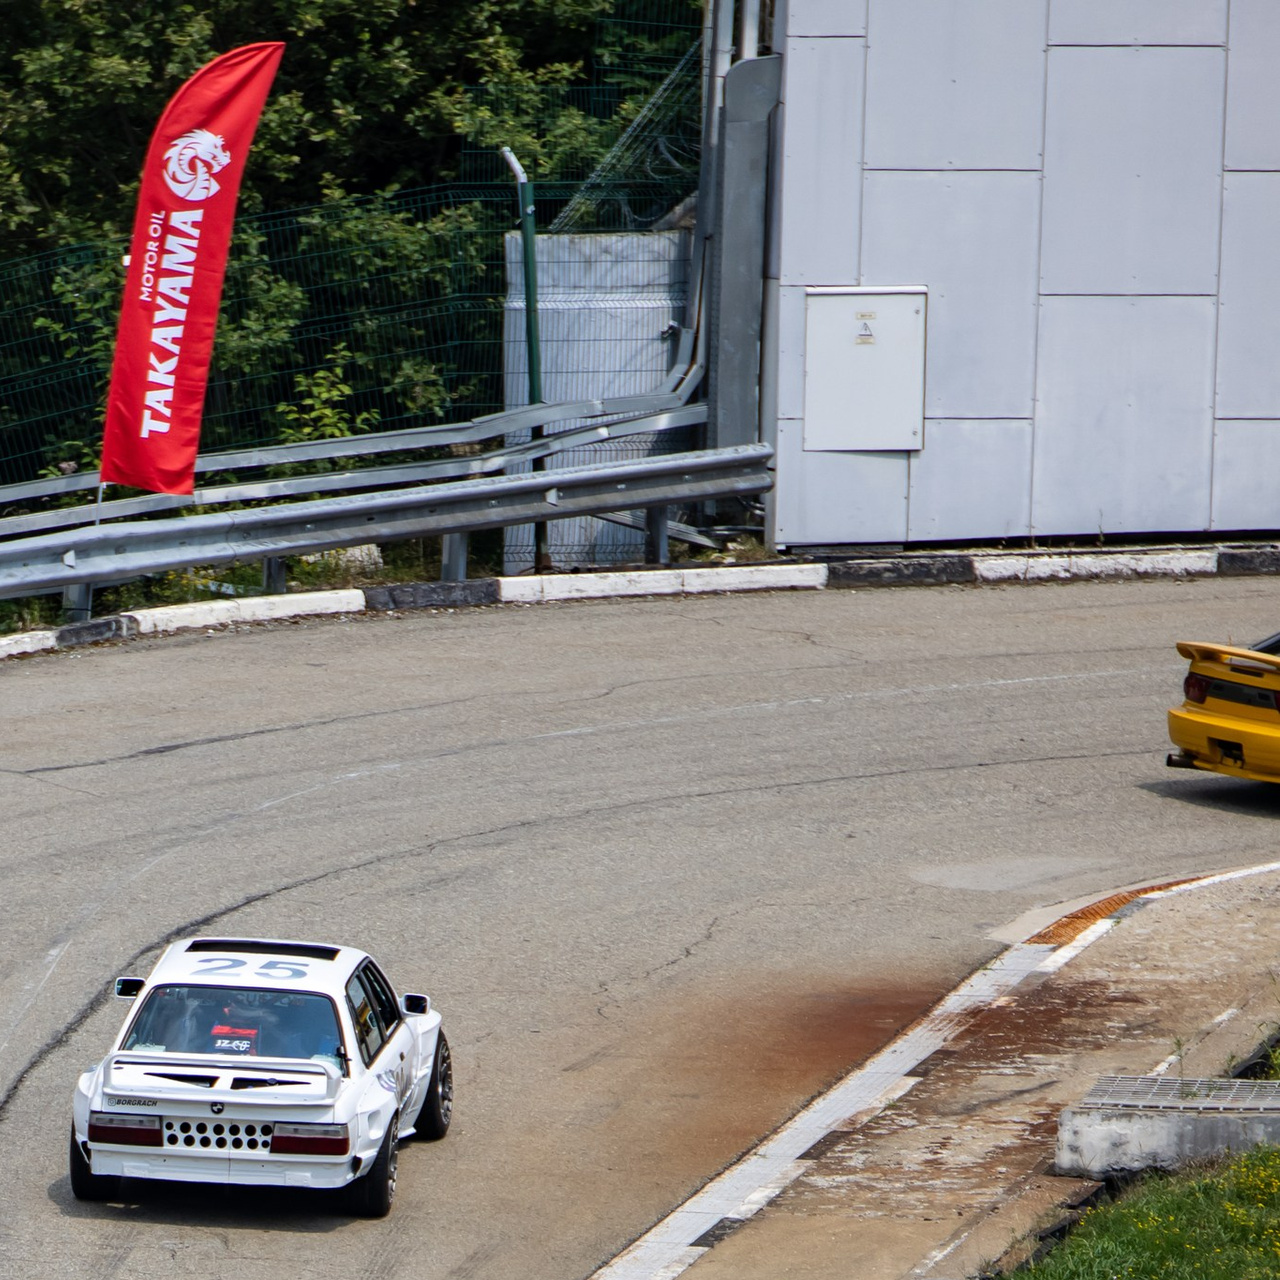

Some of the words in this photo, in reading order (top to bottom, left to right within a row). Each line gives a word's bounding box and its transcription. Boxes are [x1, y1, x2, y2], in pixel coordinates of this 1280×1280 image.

[149, 210, 166, 238] OIL
[139, 241, 160, 302] MOTOR
[139, 208, 204, 440] TAKAYAMA
[189, 958, 309, 981] 25
